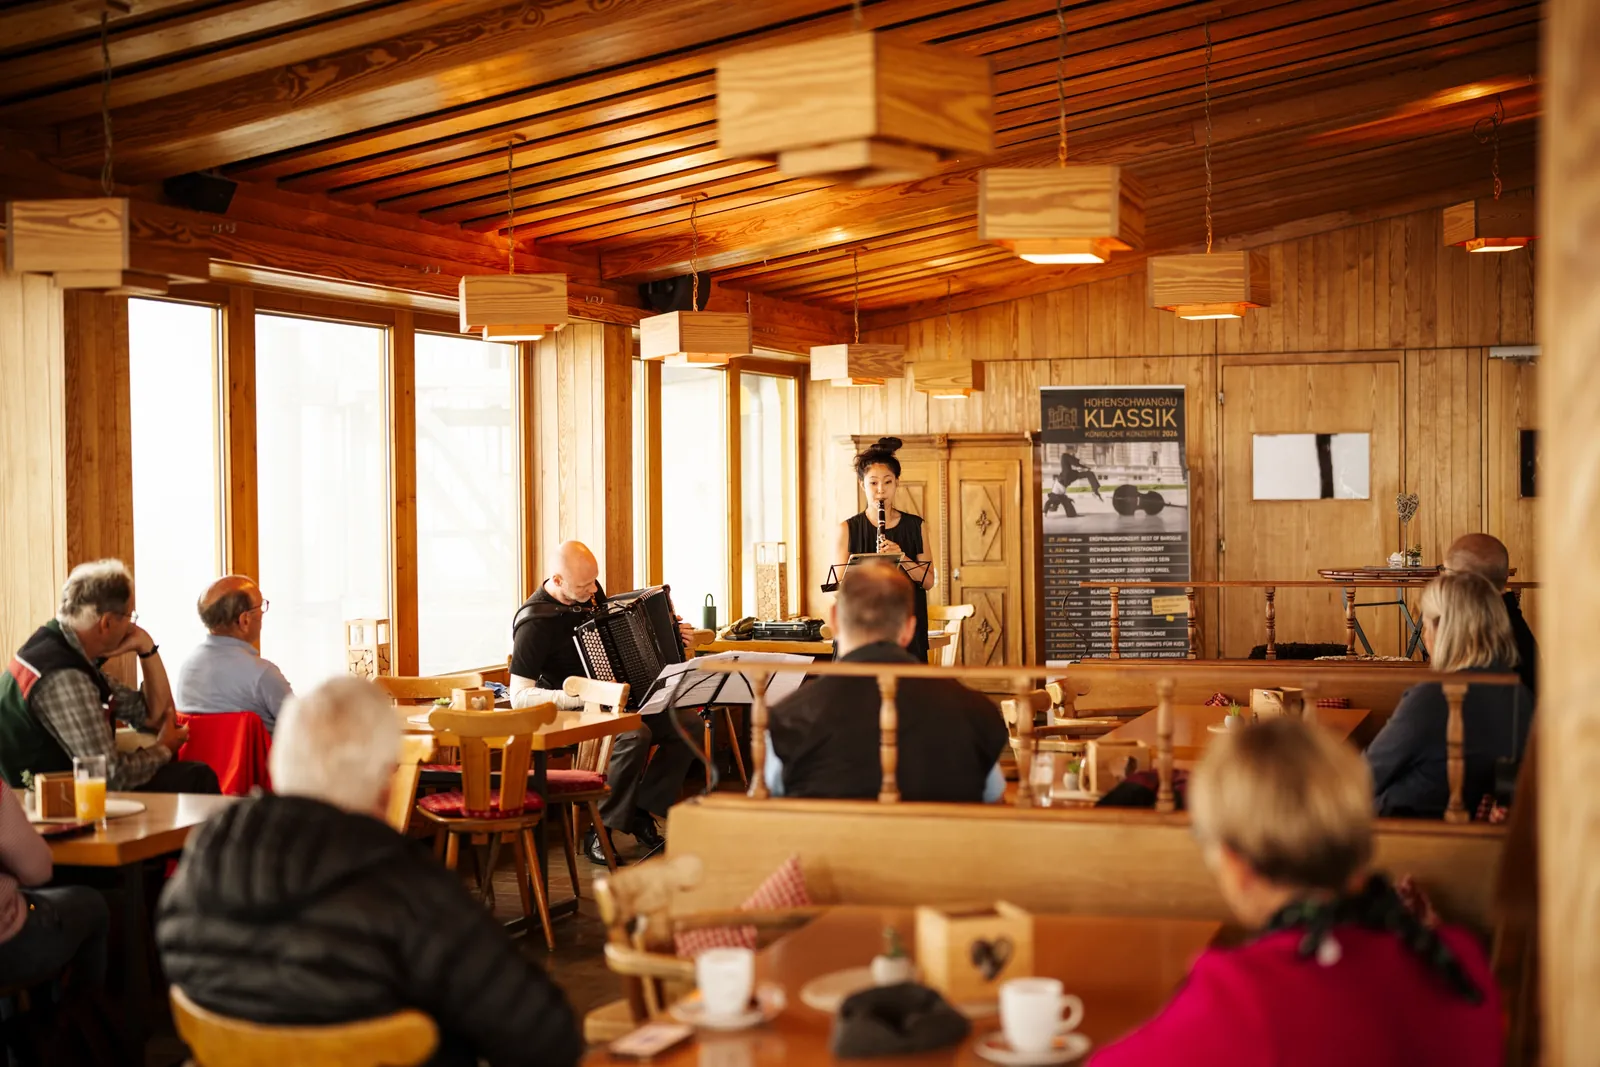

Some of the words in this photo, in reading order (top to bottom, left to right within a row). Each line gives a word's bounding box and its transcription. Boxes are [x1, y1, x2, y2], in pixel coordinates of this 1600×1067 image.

[1084, 397, 1177, 407] HOHENSCHWANGAU
[1084, 408, 1177, 428] KLASSIK
[1085, 429, 1124, 438] KÖNIGLICHE
